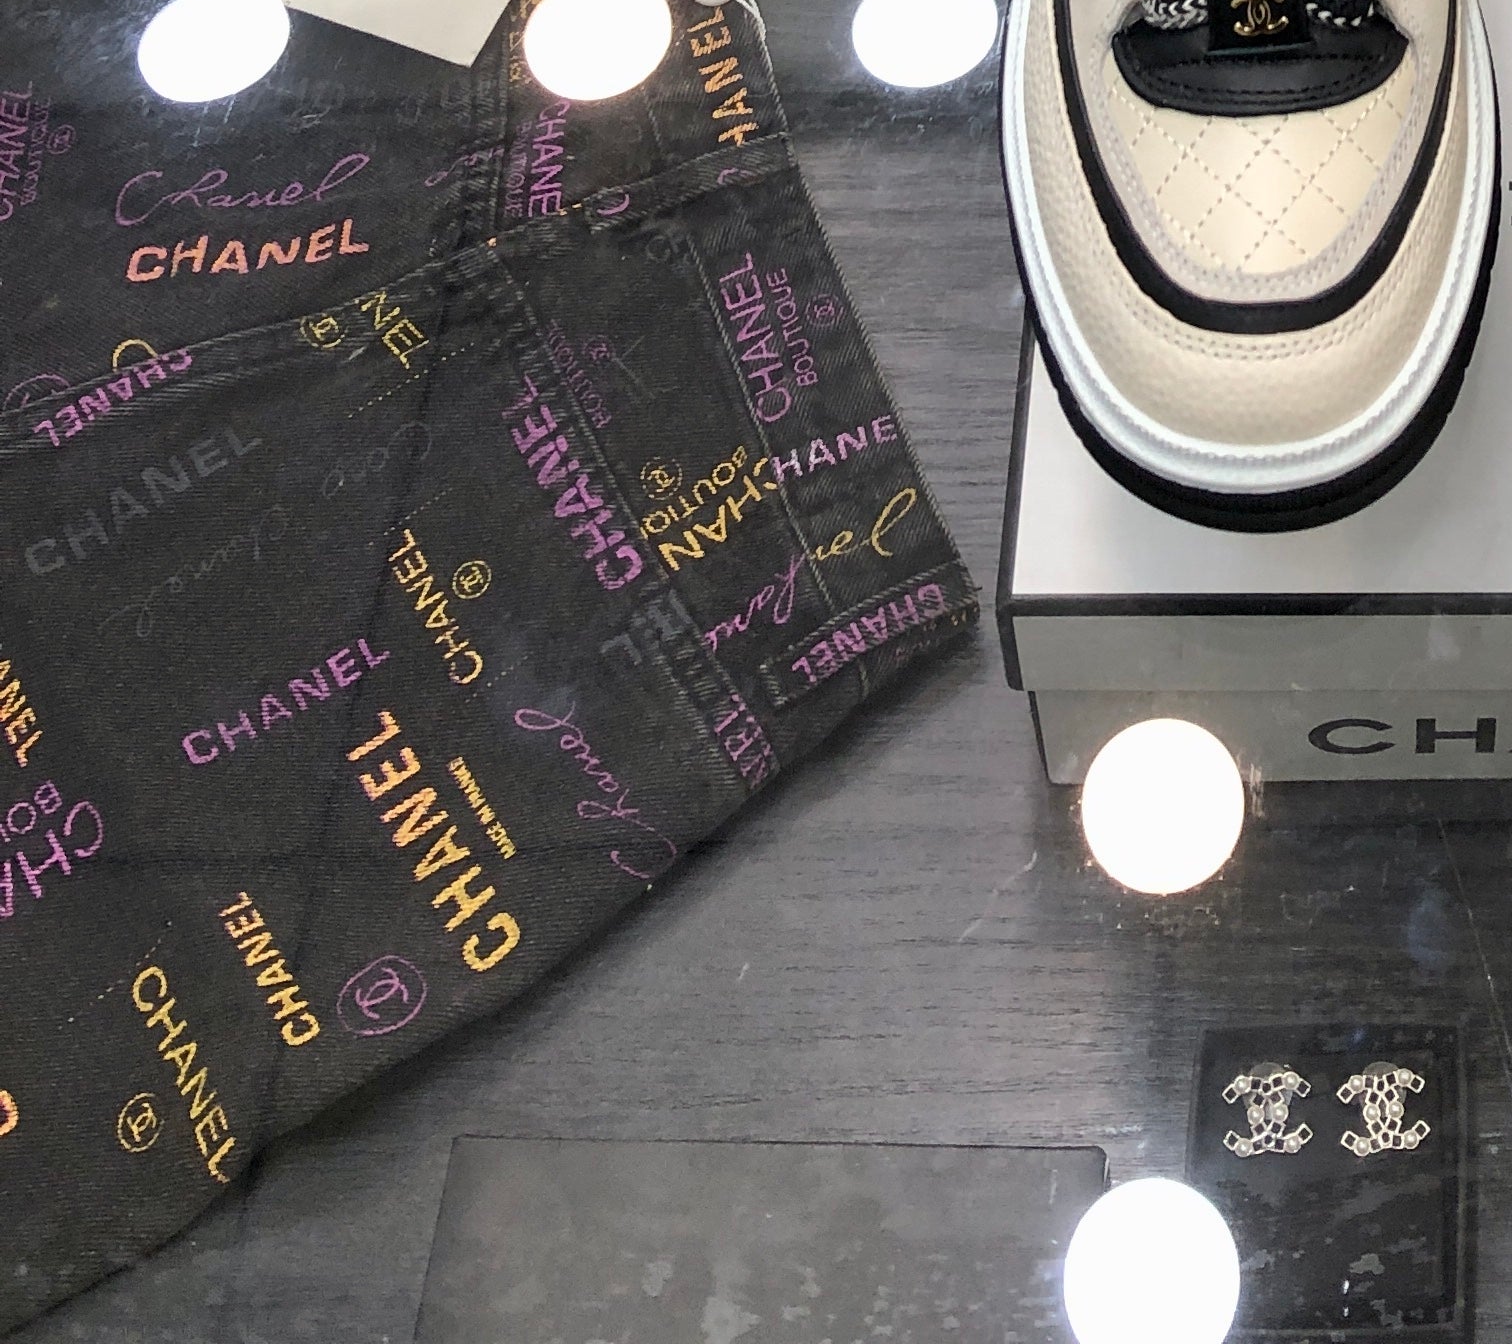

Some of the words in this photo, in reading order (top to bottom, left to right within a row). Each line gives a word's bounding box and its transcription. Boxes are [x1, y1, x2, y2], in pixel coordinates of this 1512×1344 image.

[114, 153, 370, 226] Chanel
[125, 218, 370, 283] CHANEL
[33, 348, 193, 447] CHANEL
[718, 252, 791, 423] CHANEL
[766, 268, 819, 387] BOUTIQUE
[502, 374, 643, 590] CHANEL
[389, 528, 484, 685] CHANEL
[791, 583, 945, 683] CHANEL
[181, 638, 391, 765] CHANEL
[345, 710, 521, 973] CHANEL
[219, 891, 321, 1047] CHANEL
[131, 965, 236, 1183] CHANEL
